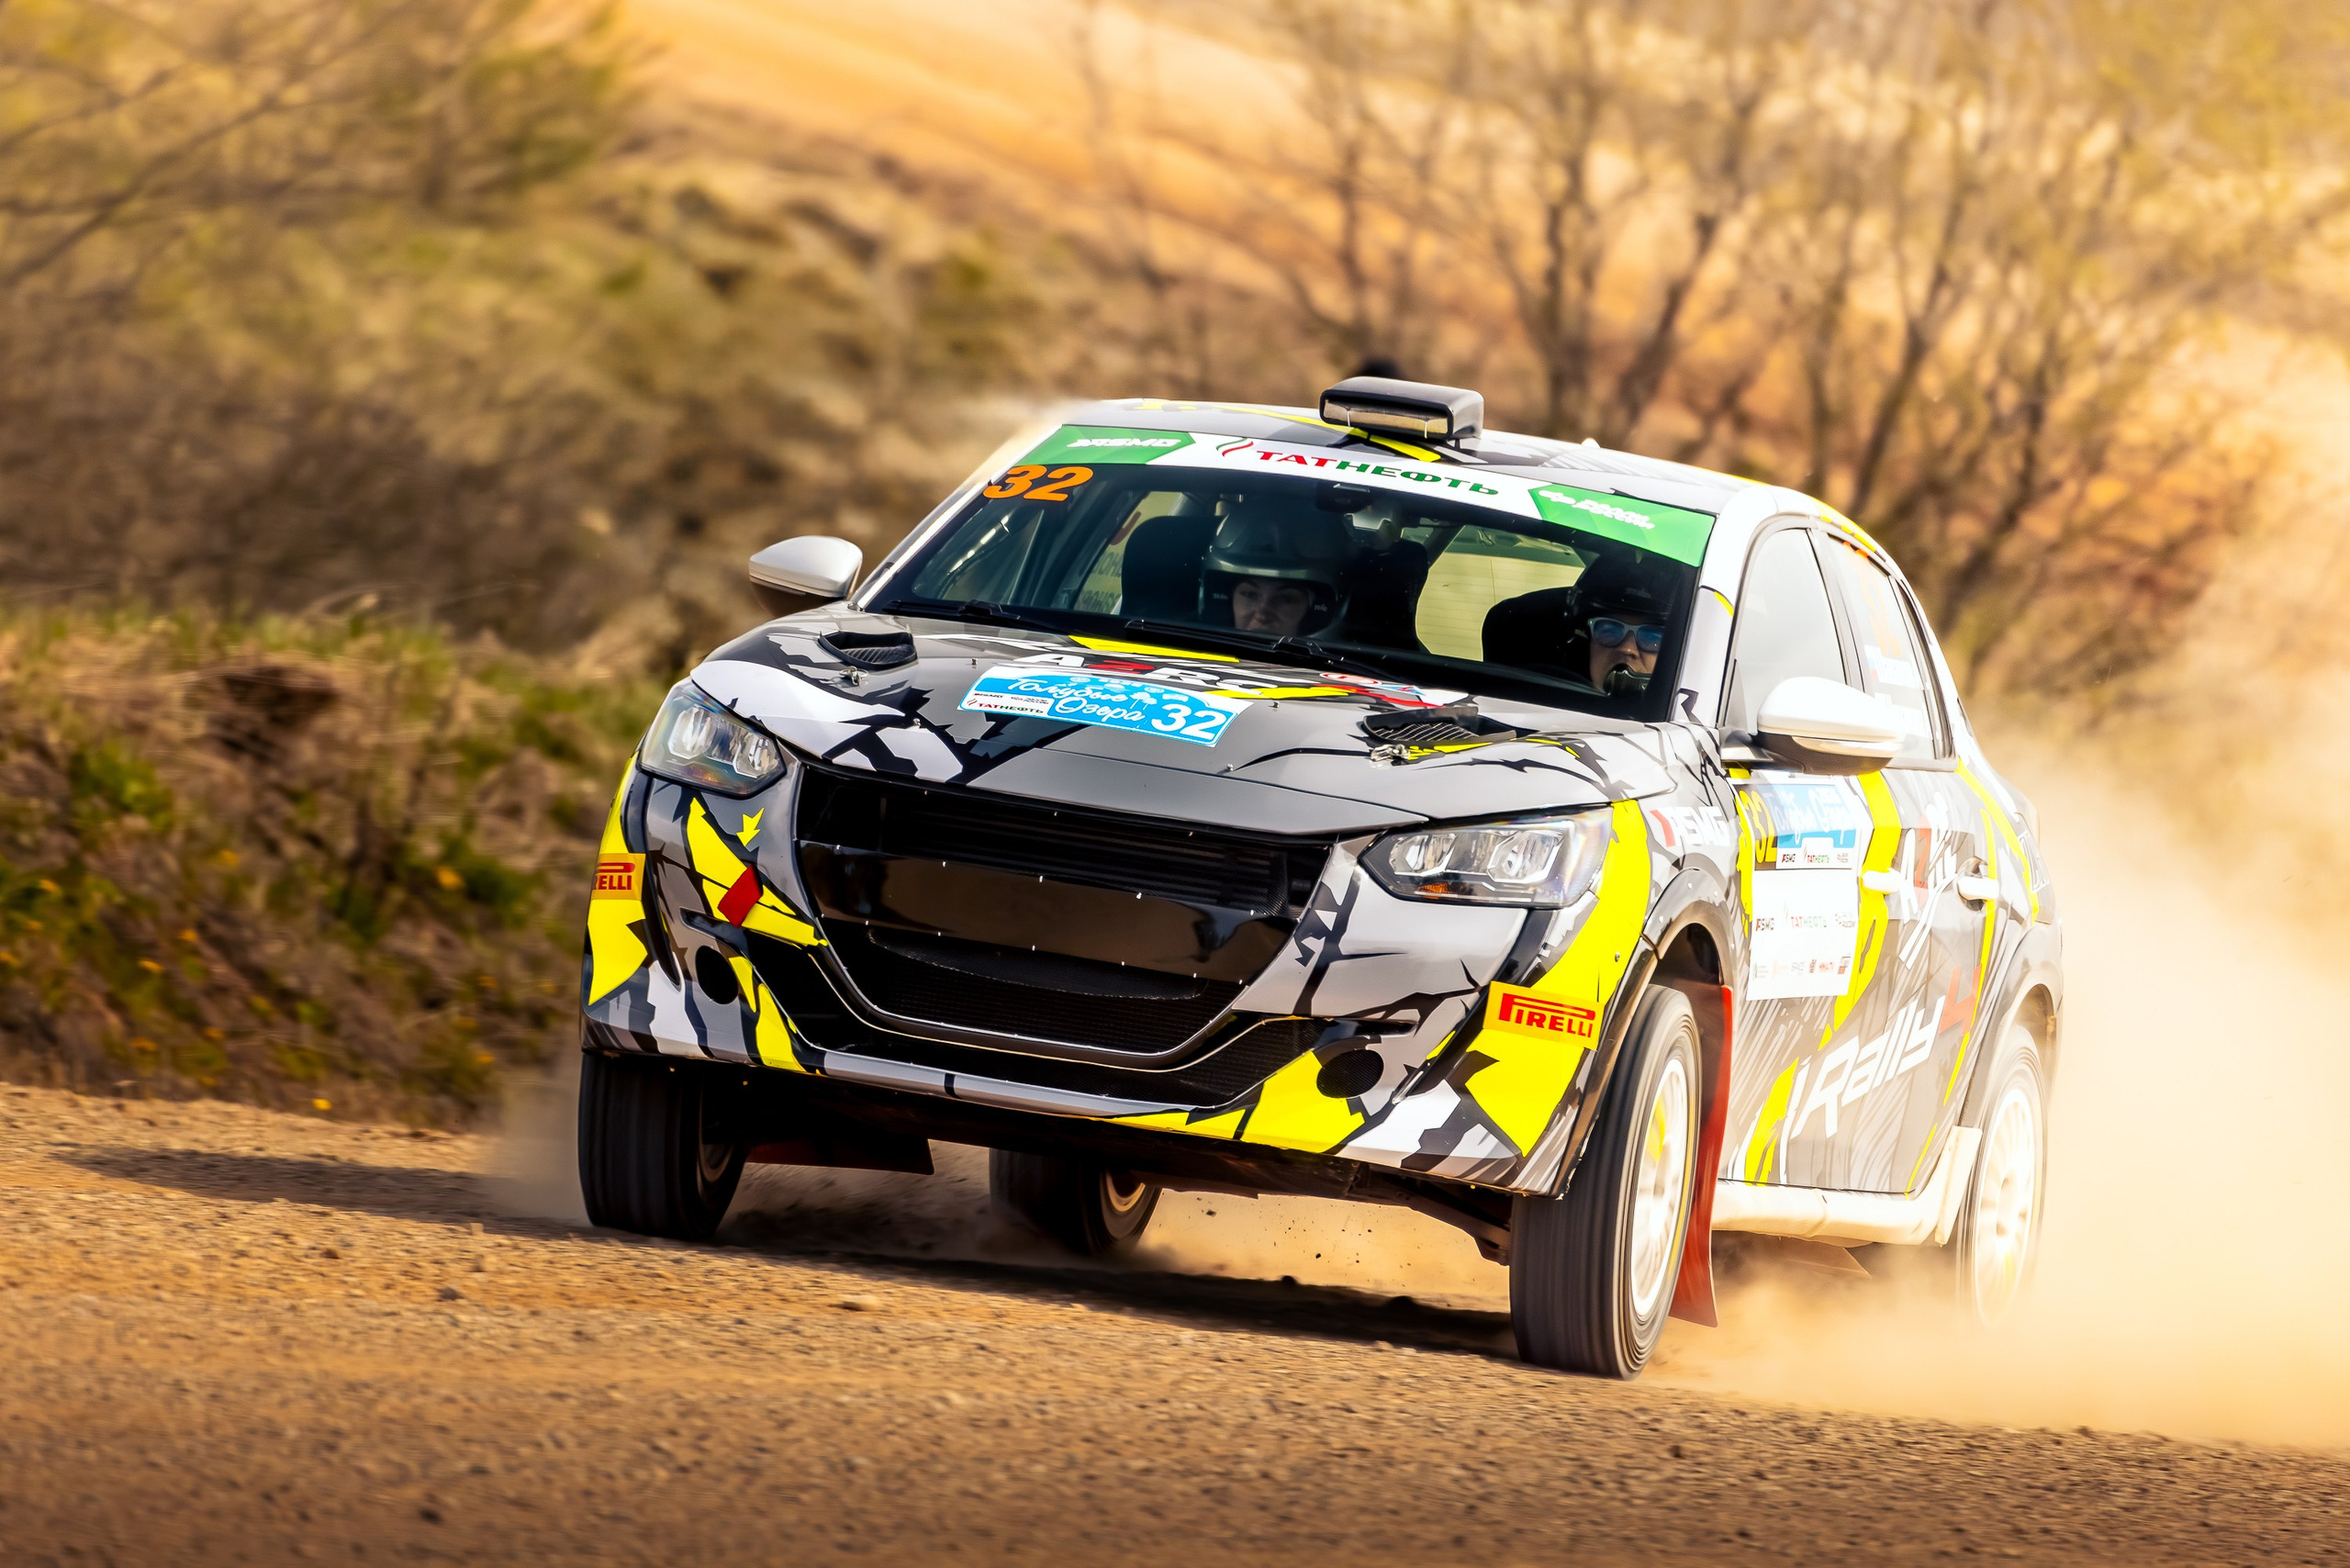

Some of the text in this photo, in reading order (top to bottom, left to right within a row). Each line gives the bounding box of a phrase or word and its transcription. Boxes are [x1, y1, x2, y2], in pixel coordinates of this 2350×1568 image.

[982, 465, 1094, 501] 32
[1256, 450, 1499, 496] ТАТНЕФТЬ
[978, 702, 1044, 713] ТАТНЕФТЬ
[1054, 696, 1146, 722] Озера
[1151, 703, 1227, 740] 32
[1739, 790, 1777, 864] 32
[594, 862, 635, 890] ELLI
[1498, 992, 1596, 1038] PIRELLI
